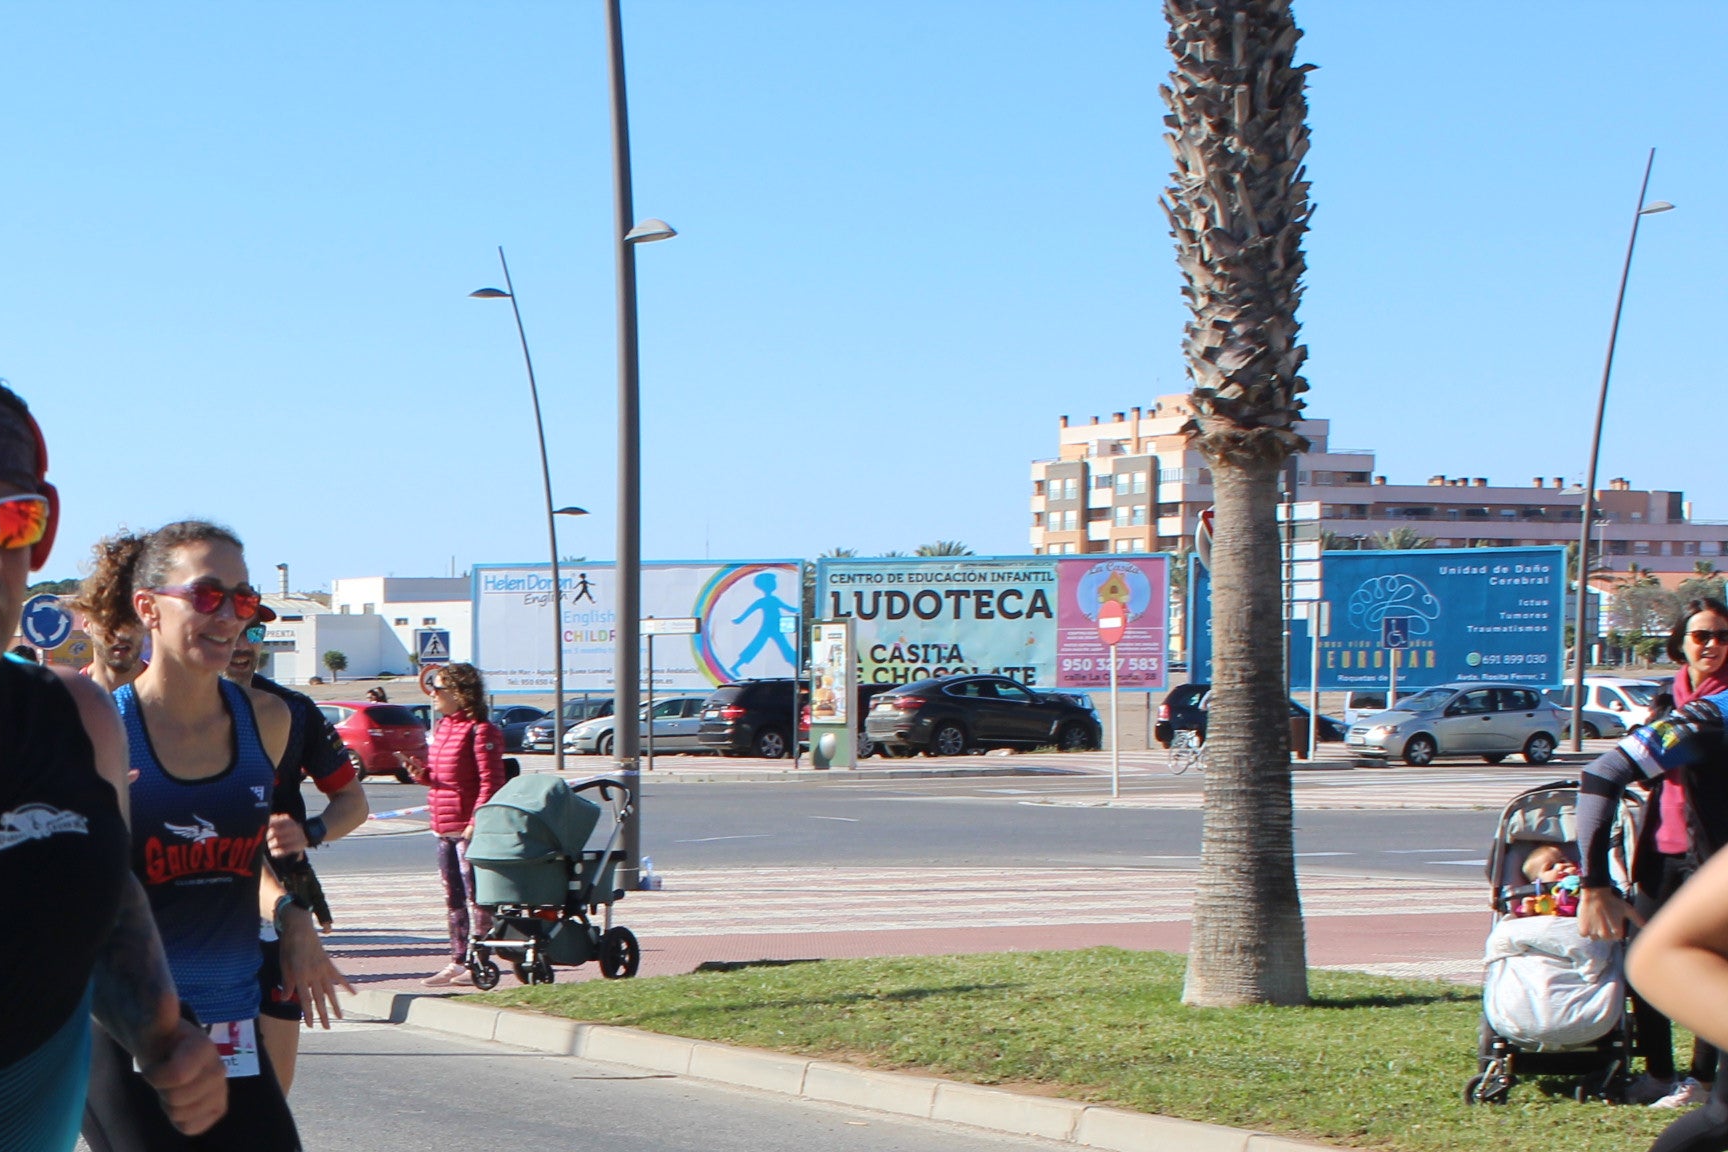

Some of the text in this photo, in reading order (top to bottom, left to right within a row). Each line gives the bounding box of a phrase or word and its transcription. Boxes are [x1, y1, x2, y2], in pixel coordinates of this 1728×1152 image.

[1439, 564, 1550, 575] Unidad de Daño
[484, 574, 571, 590] Helen Dorn
[829, 570, 1054, 583] CENTRO DE EDUCACIÓN INFANTIL
[1489, 576, 1550, 586] Cerebral
[830, 588, 1053, 620] LUDOTECA
[564, 629, 616, 642] CHILDR
[1466, 625, 1548, 633] Traumatismos
[869, 644, 964, 664] CASITA
[1481, 654, 1501, 664] 691
[1525, 654, 1548, 664] 030
[1062, 658, 1091, 671] 950
[1129, 657, 1158, 671] 583
